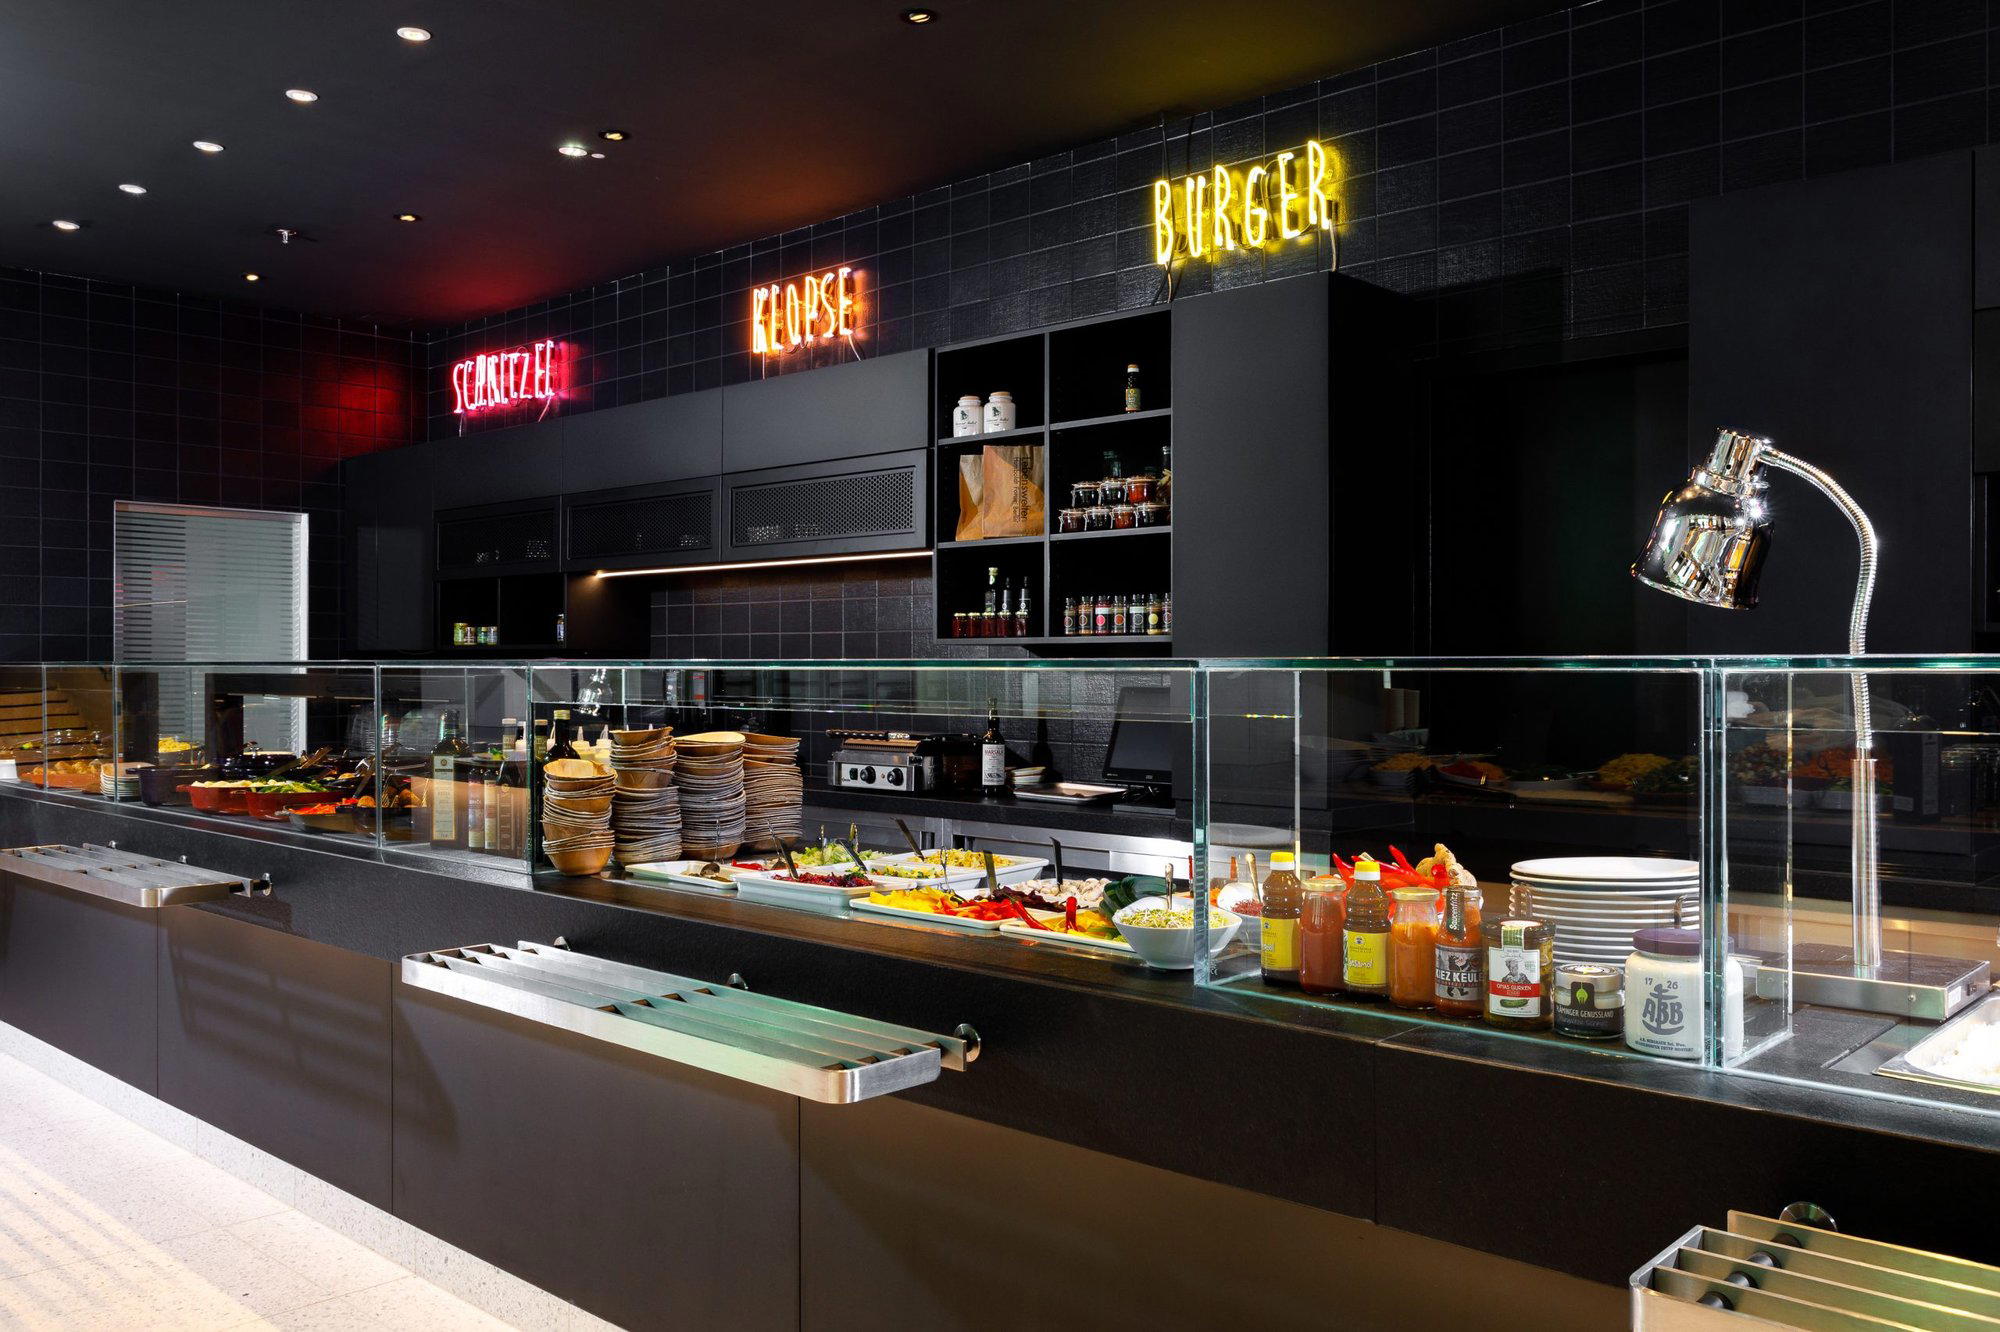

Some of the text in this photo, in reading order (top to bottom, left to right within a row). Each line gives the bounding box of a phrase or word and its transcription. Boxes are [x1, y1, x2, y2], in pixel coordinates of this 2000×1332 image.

[1154, 139, 1331, 266] BURGER
[752, 266, 854, 354] KLOPSE
[452, 339, 556, 414] SCHNITZEL
[1644, 977, 1678, 989] 17 26
